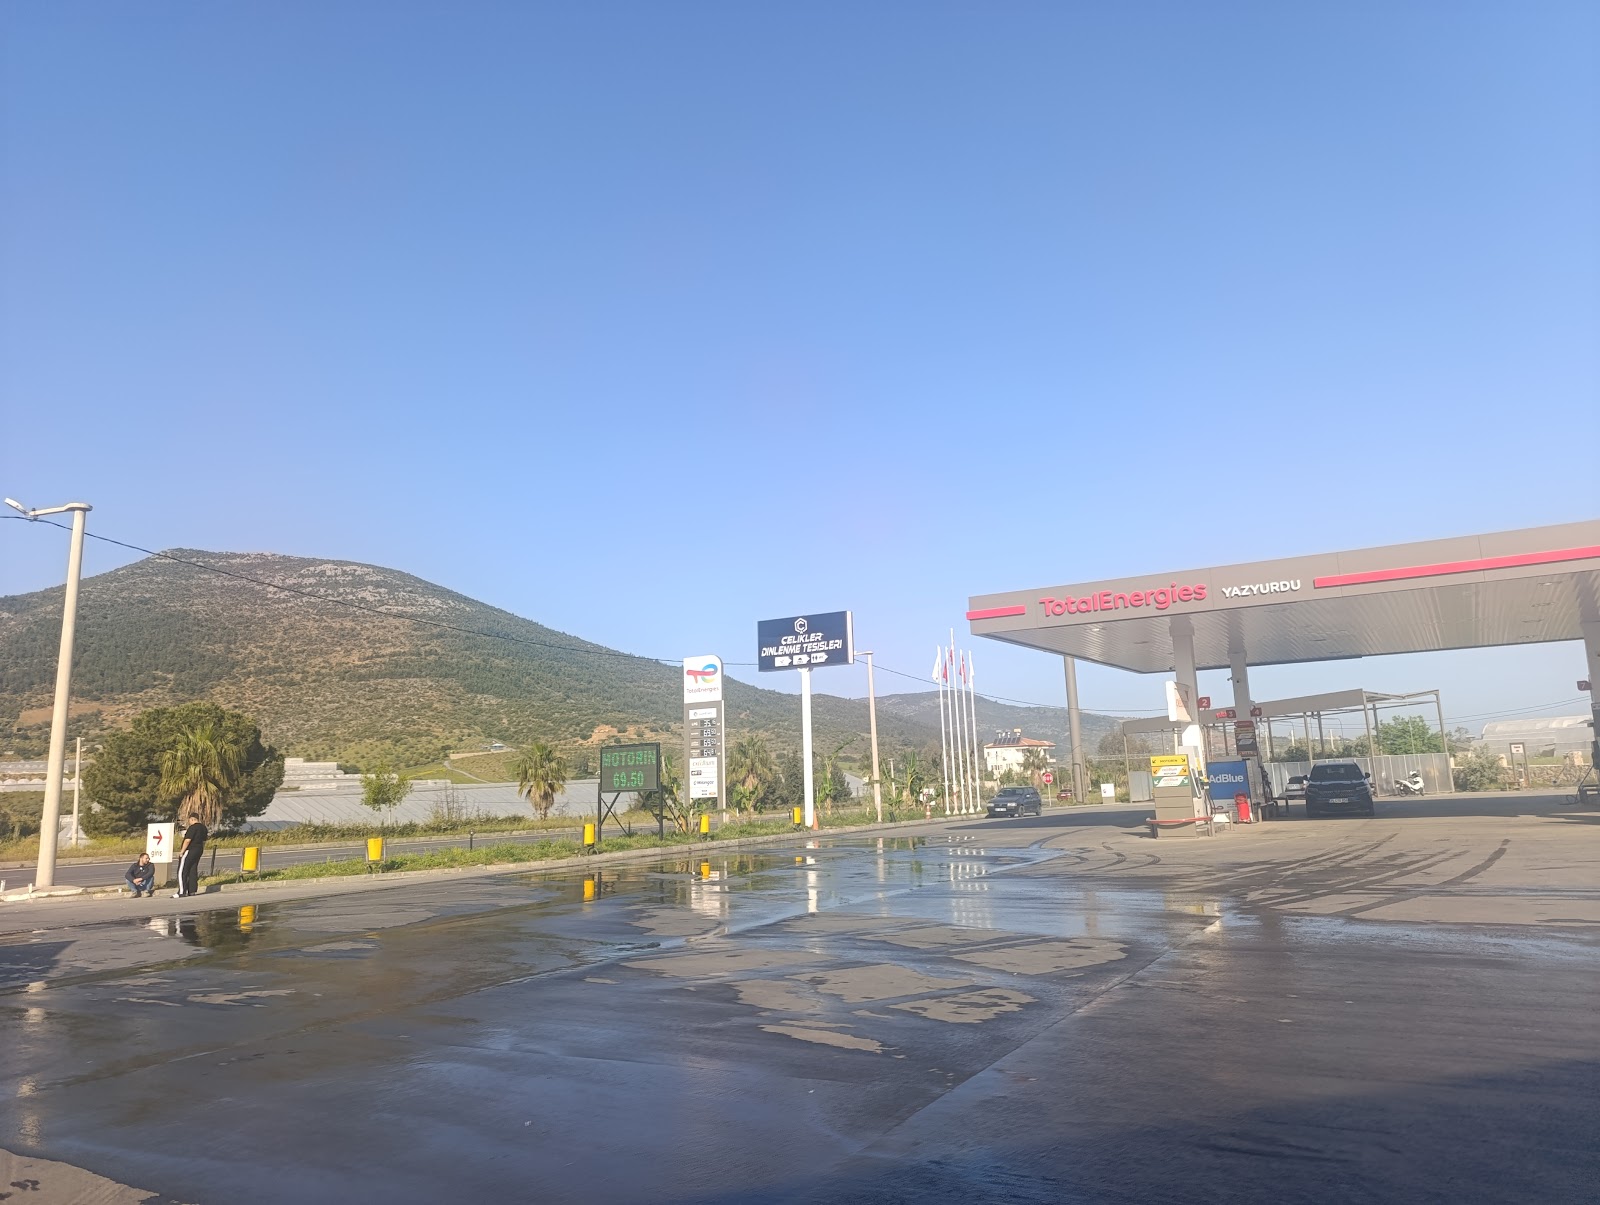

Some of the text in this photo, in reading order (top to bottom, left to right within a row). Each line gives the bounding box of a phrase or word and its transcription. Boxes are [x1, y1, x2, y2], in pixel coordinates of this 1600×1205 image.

[1039, 579, 1301, 617] TotalEnergies YAZYURDU
[614, 771, 644, 788] 69.50
[1209, 774, 1244, 783] AdBlue
